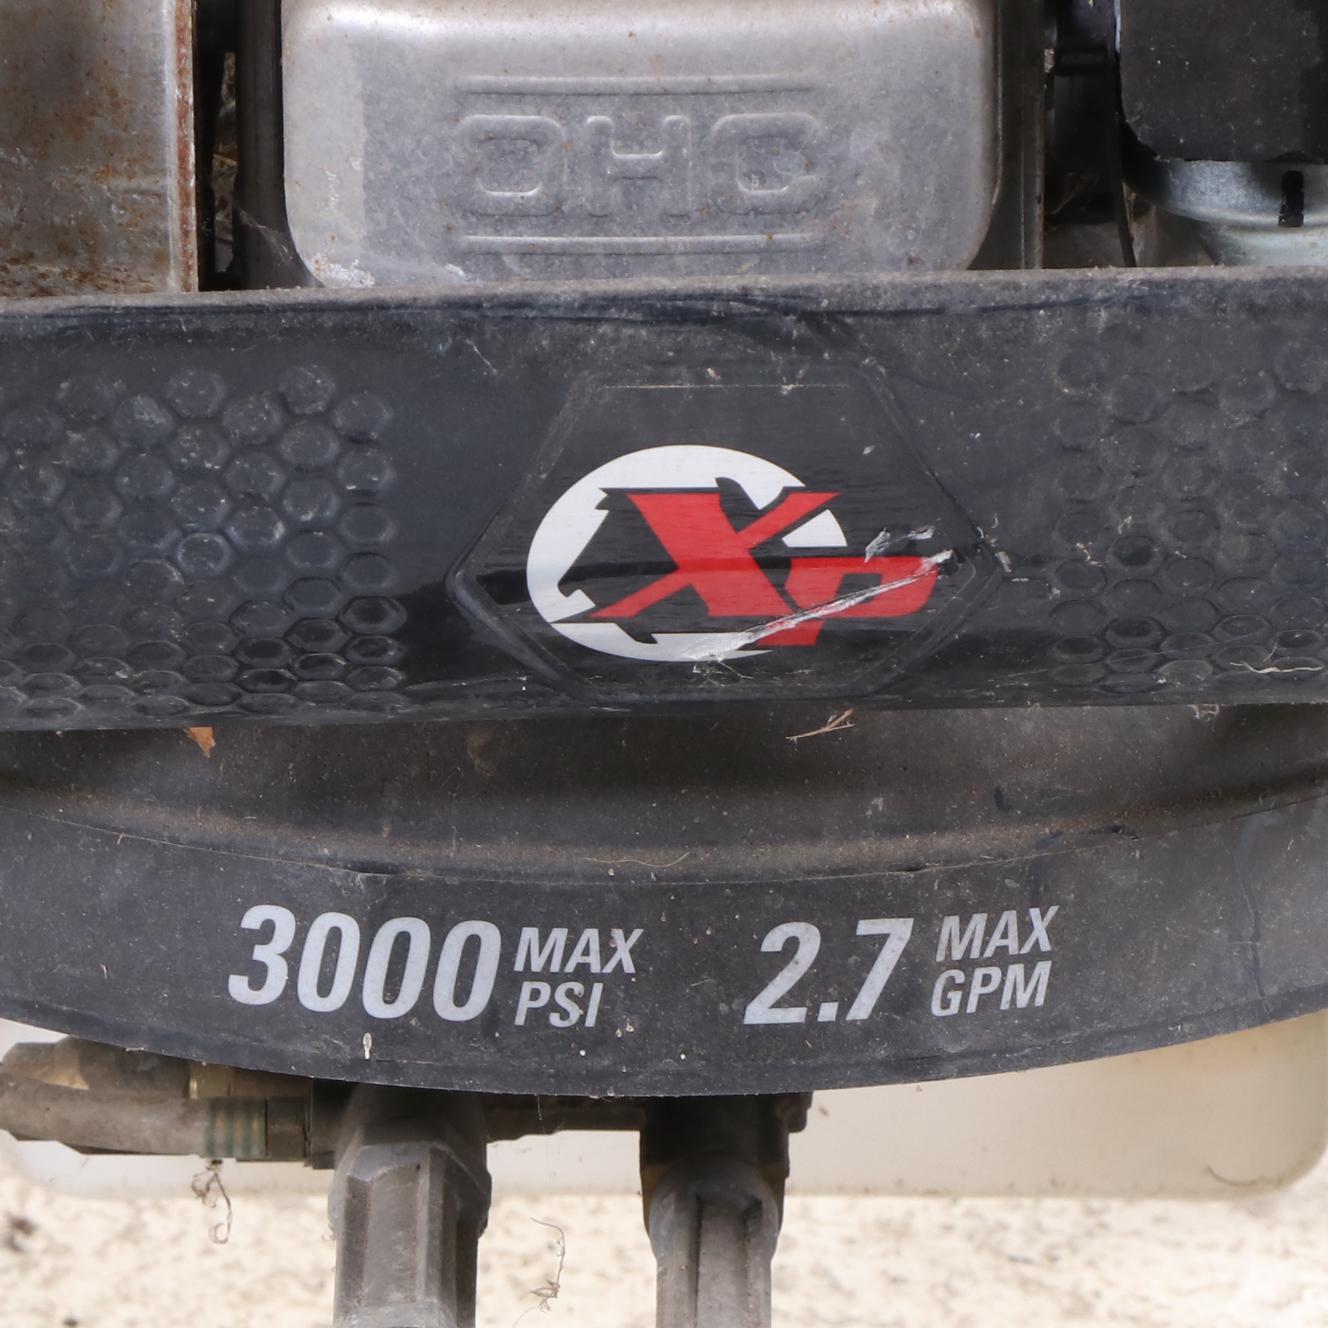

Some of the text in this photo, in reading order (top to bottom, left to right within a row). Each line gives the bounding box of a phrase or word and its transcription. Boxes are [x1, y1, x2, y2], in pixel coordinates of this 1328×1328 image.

[514, 927, 643, 973] MAX
[936, 906, 1059, 961] MAX
[228, 905, 501, 1021] 3000
[744, 918, 913, 1024] 2.7
[931, 961, 1051, 1016] GPM
[515, 982, 603, 1027] PSI
